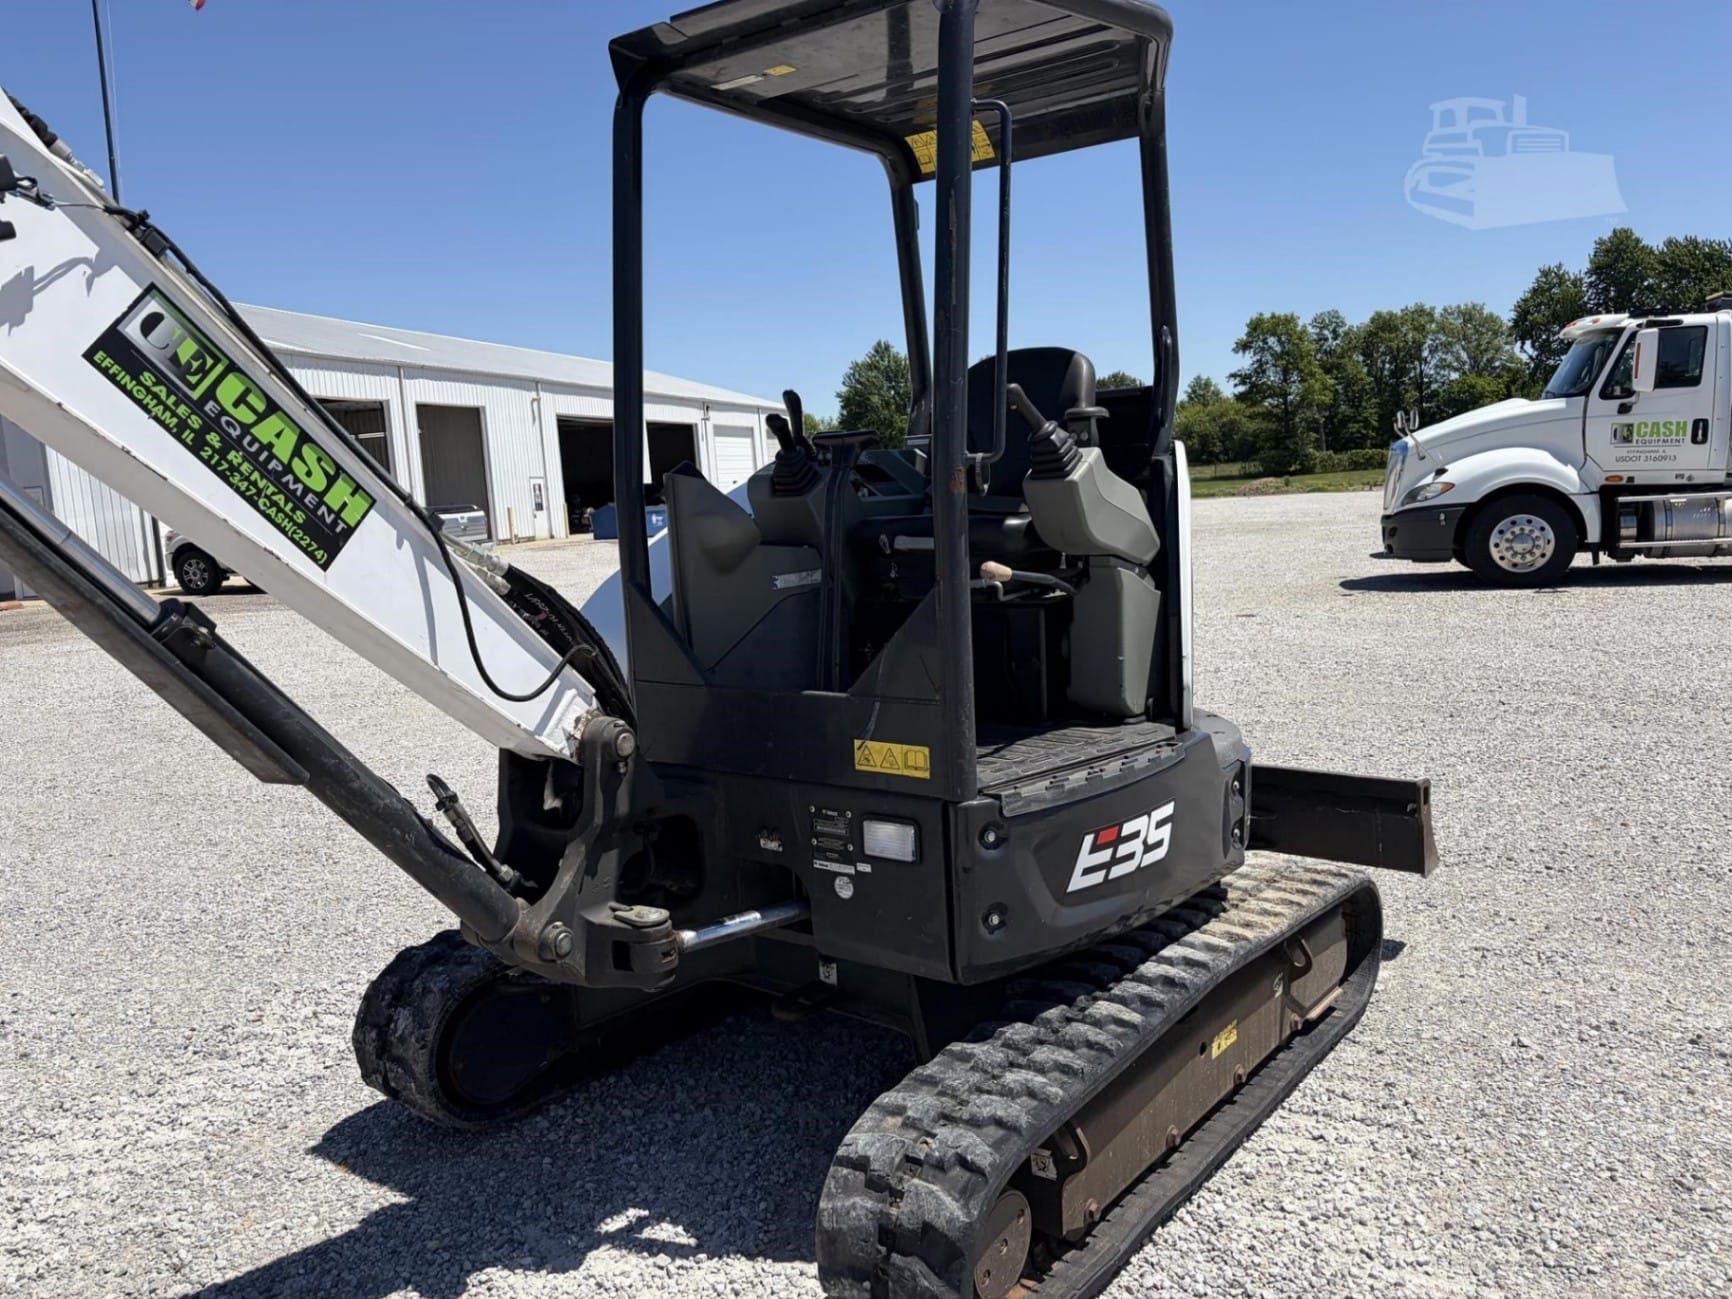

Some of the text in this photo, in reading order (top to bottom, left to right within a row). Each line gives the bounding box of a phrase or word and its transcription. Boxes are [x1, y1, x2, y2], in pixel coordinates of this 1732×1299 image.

[93, 350, 328, 565] EFFINGHAM, IL 217-347-CASH(2274)
[139, 371, 306, 524] SALES & RENTALS
[203, 400, 349, 535] EQUIPMENT
[215, 371, 372, 528] CASH
[1615, 454, 1677, 463] USDOT 3160913
[1635, 420, 1688, 438] CASH
[1635, 437, 1686, 445] EQUIPMENT
[1066, 800, 1175, 893] E35
